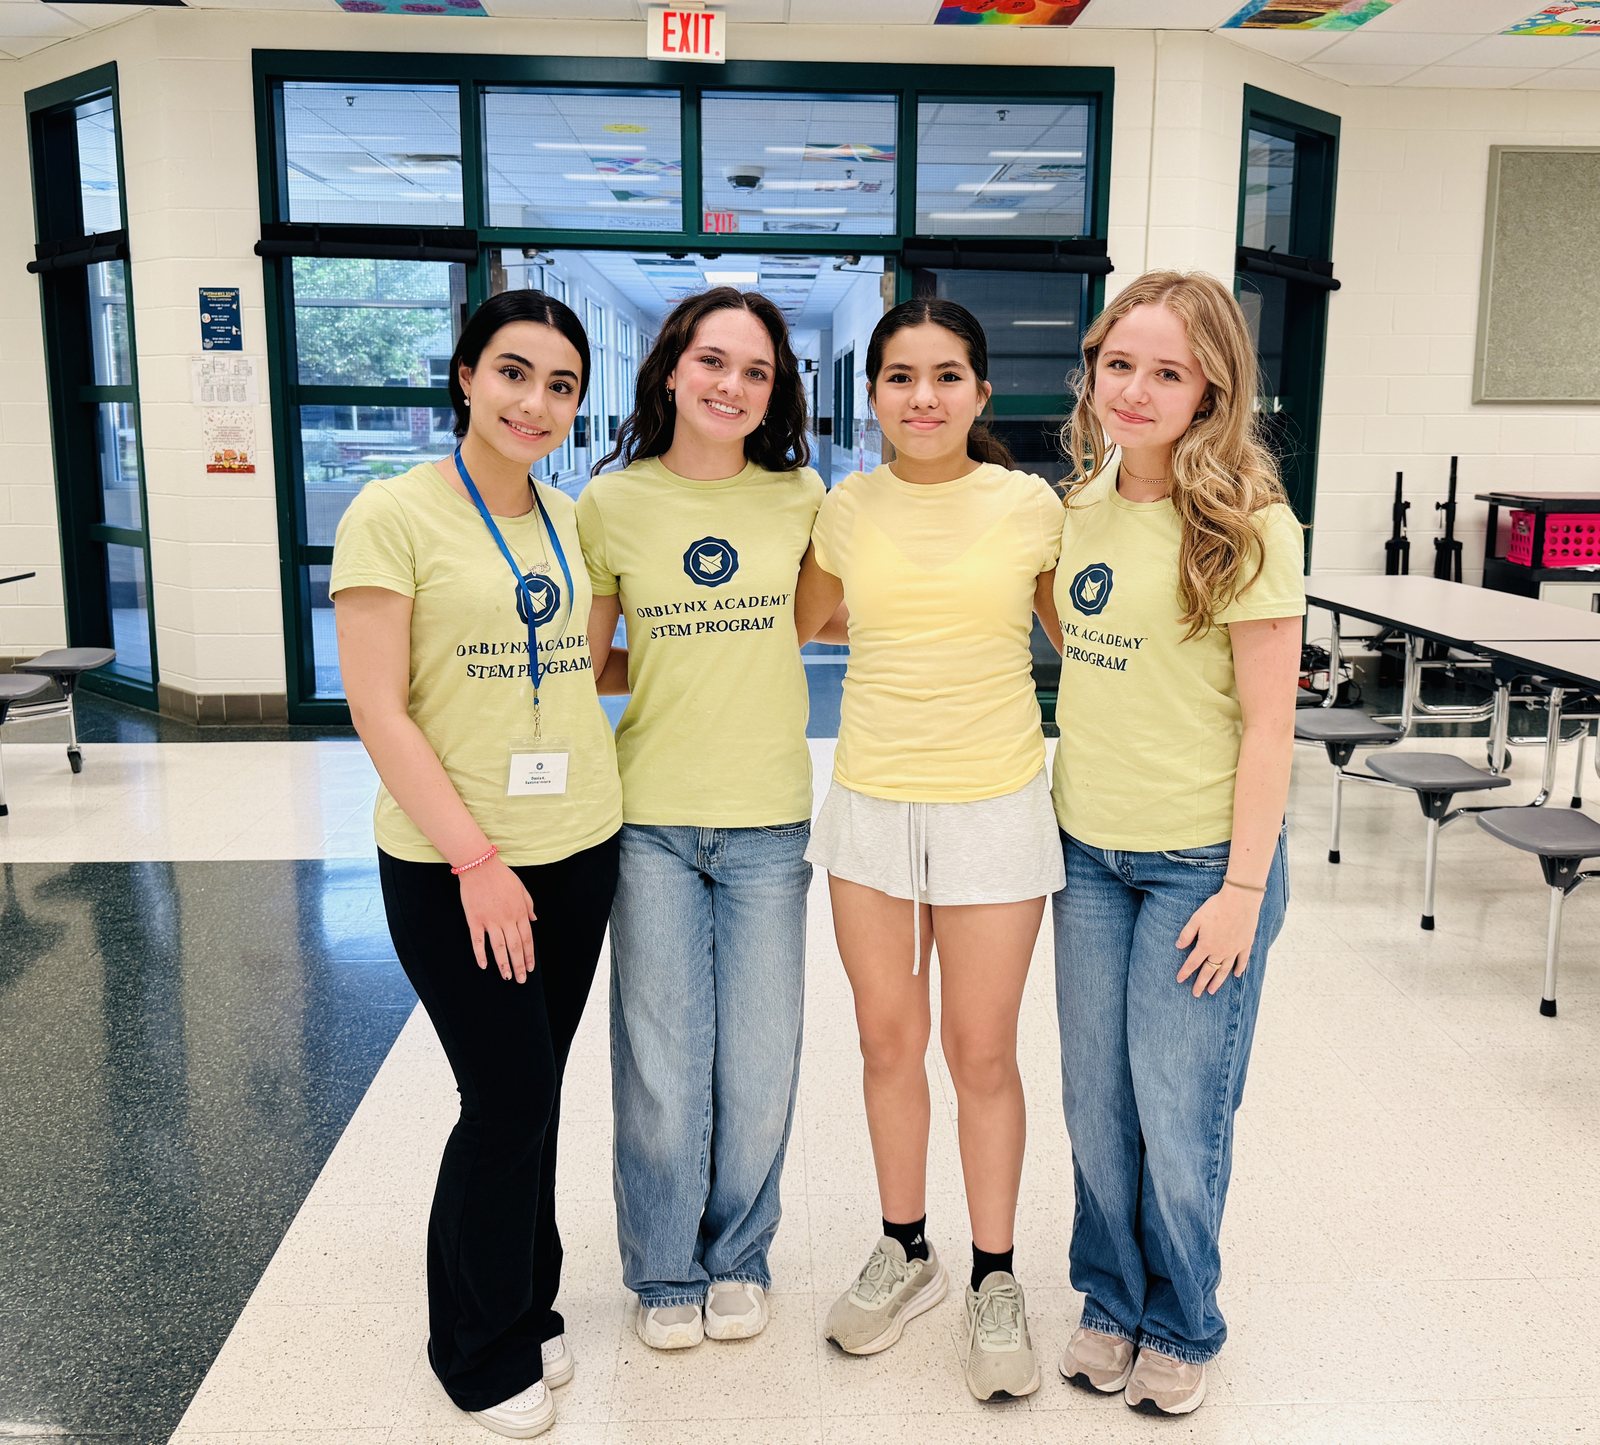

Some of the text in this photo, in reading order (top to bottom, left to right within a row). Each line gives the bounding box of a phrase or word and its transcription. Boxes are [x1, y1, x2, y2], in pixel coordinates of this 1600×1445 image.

[663, 12, 715, 54] EXIT
[704, 212, 734, 233] EXIT
[637, 594, 789, 618] ORBLYNX ACADEMY
[650, 616, 775, 640] STEM PROGRAM
[1081, 628, 1145, 650] ACADEMY
[536, 634, 588, 652] ACADE
[1066, 645, 1128, 671] PROGRAM
[467, 664, 515, 679] STEM
